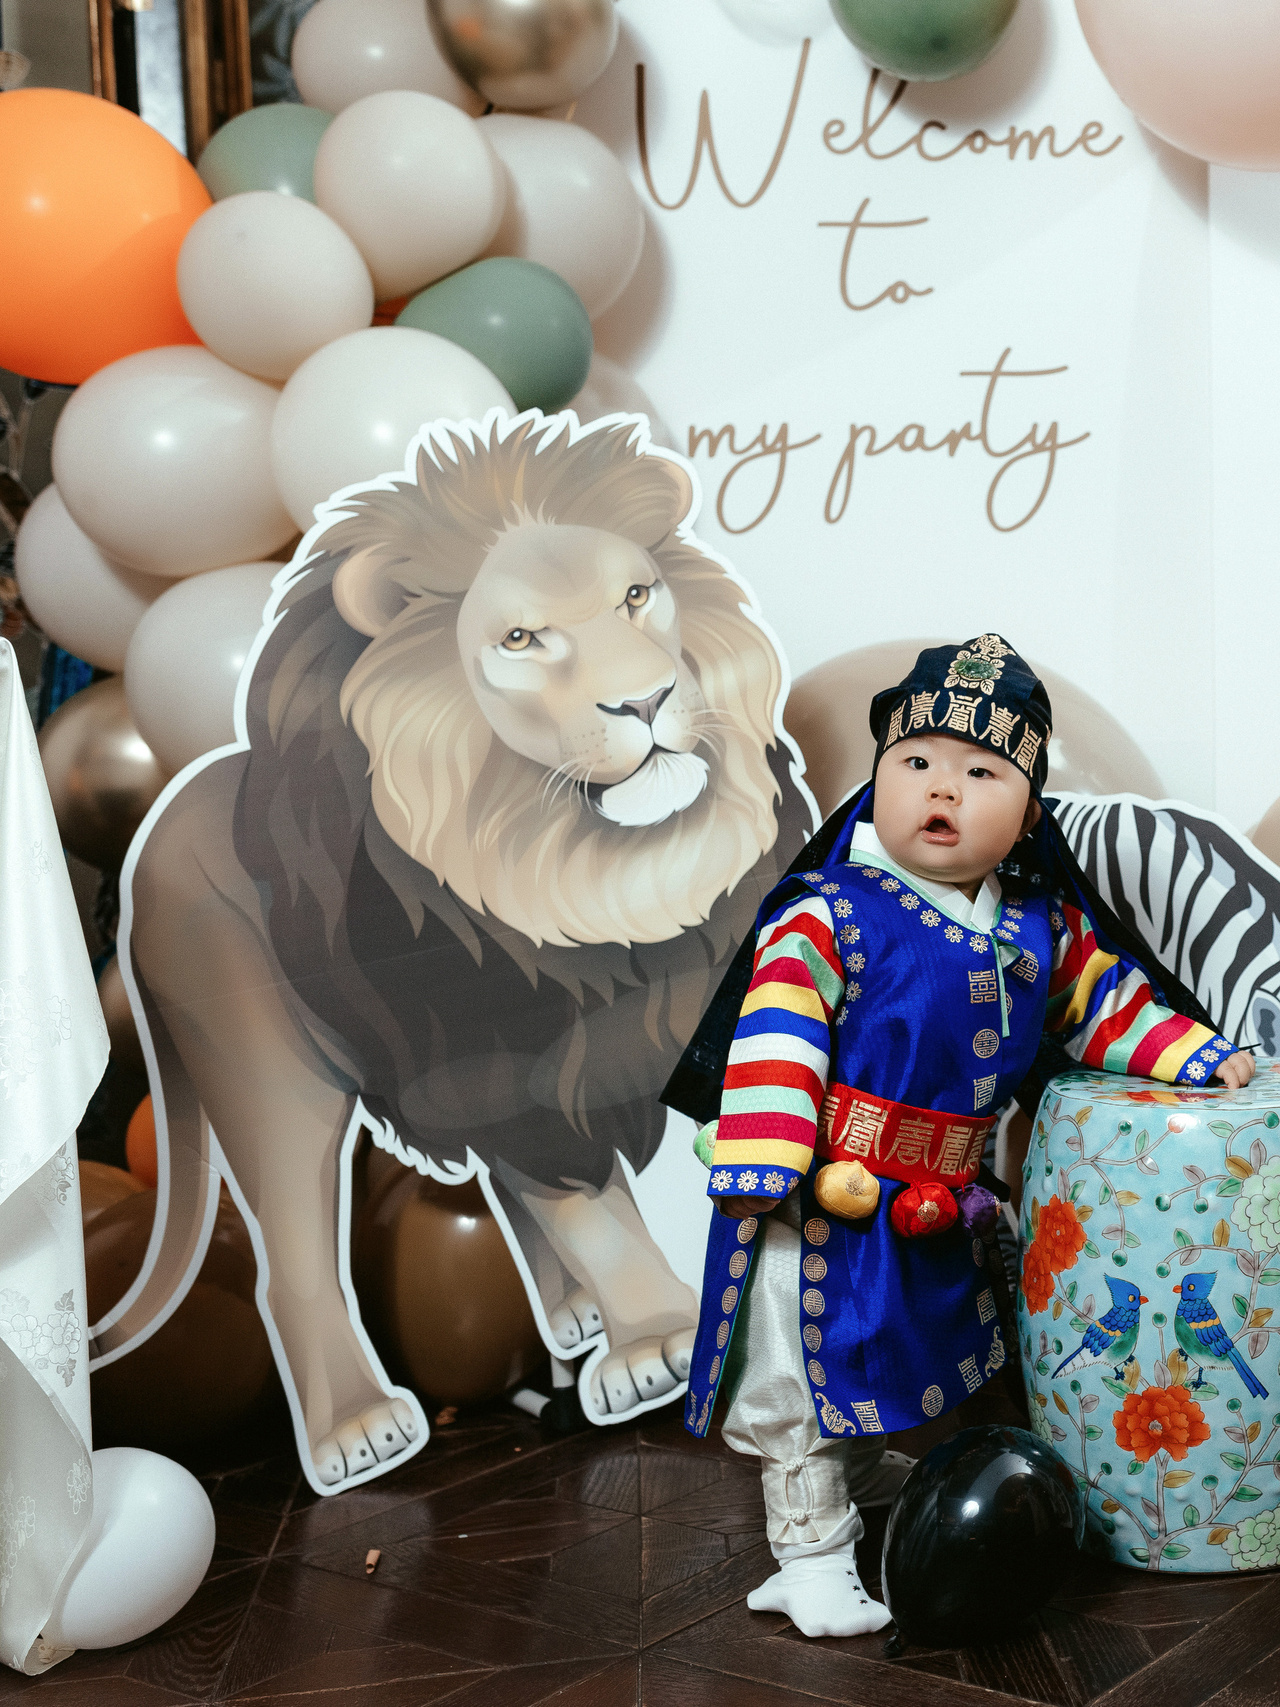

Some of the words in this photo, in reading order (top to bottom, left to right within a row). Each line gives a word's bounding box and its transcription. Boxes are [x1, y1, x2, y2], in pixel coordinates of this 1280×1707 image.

[635, 38, 1123, 210] Welcome
[818, 198, 933, 311] to
[688, 423, 821, 533] my
[824, 347, 1090, 532] party
